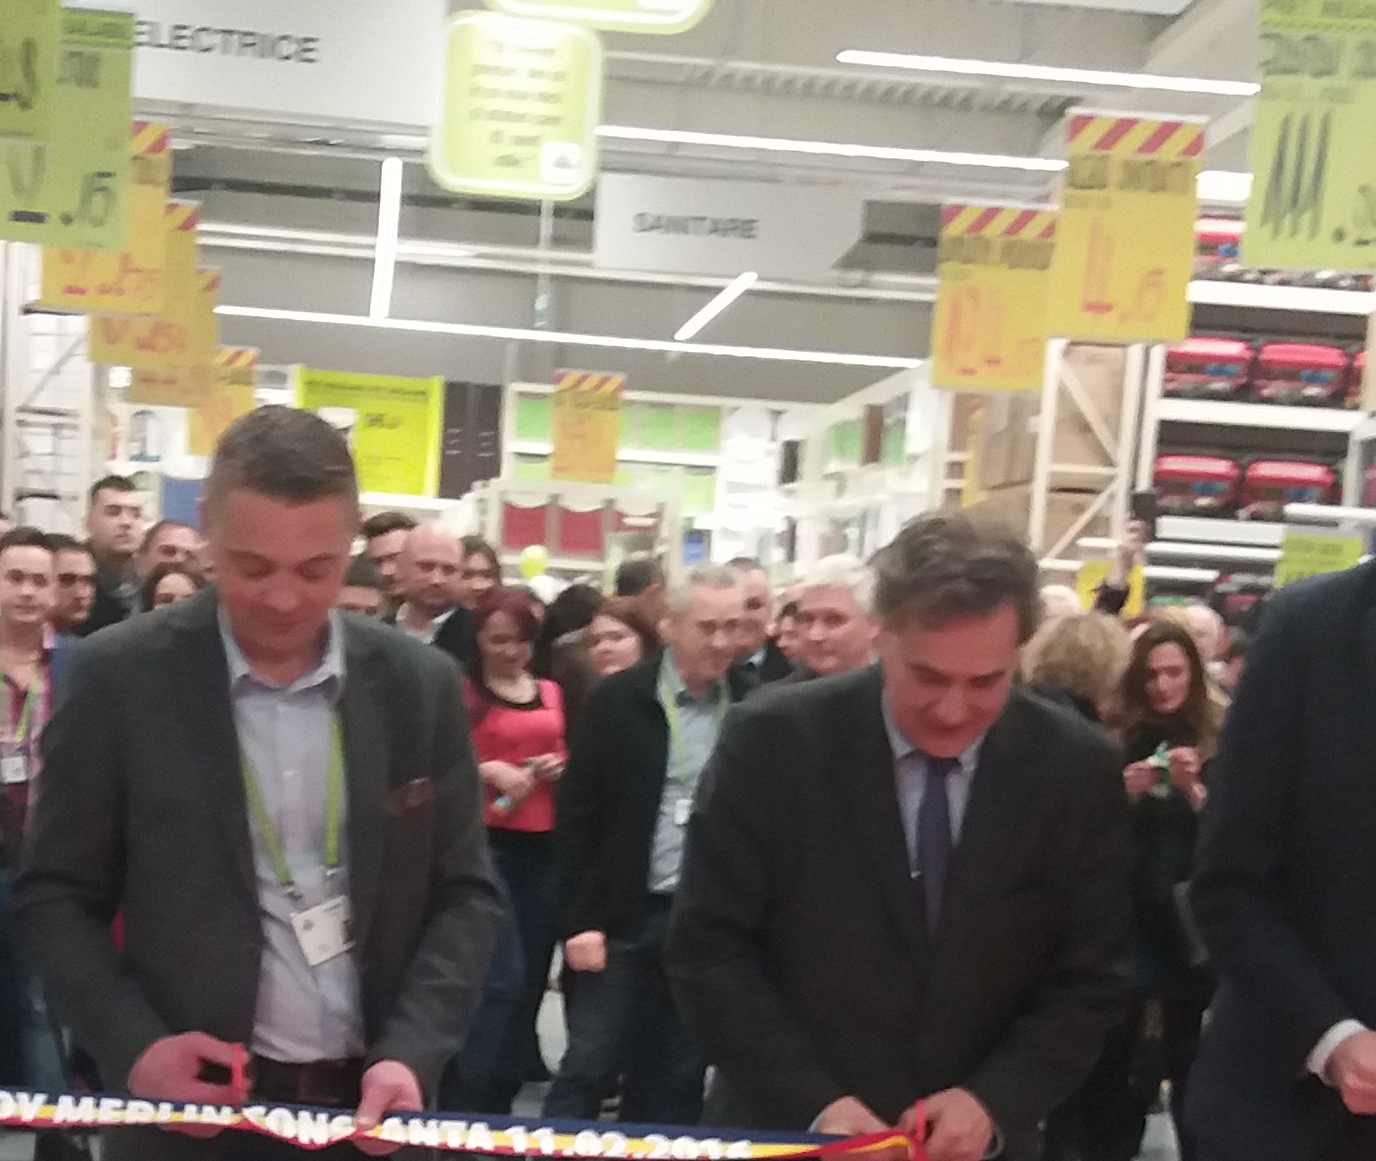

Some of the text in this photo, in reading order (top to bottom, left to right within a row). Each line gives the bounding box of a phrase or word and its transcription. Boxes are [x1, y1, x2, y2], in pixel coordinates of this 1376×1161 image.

[632, 211, 759, 240] SANITARE
[52, 1094, 234, 1126] MERLIN
[243, 1105, 494, 1150] CONSANTA
